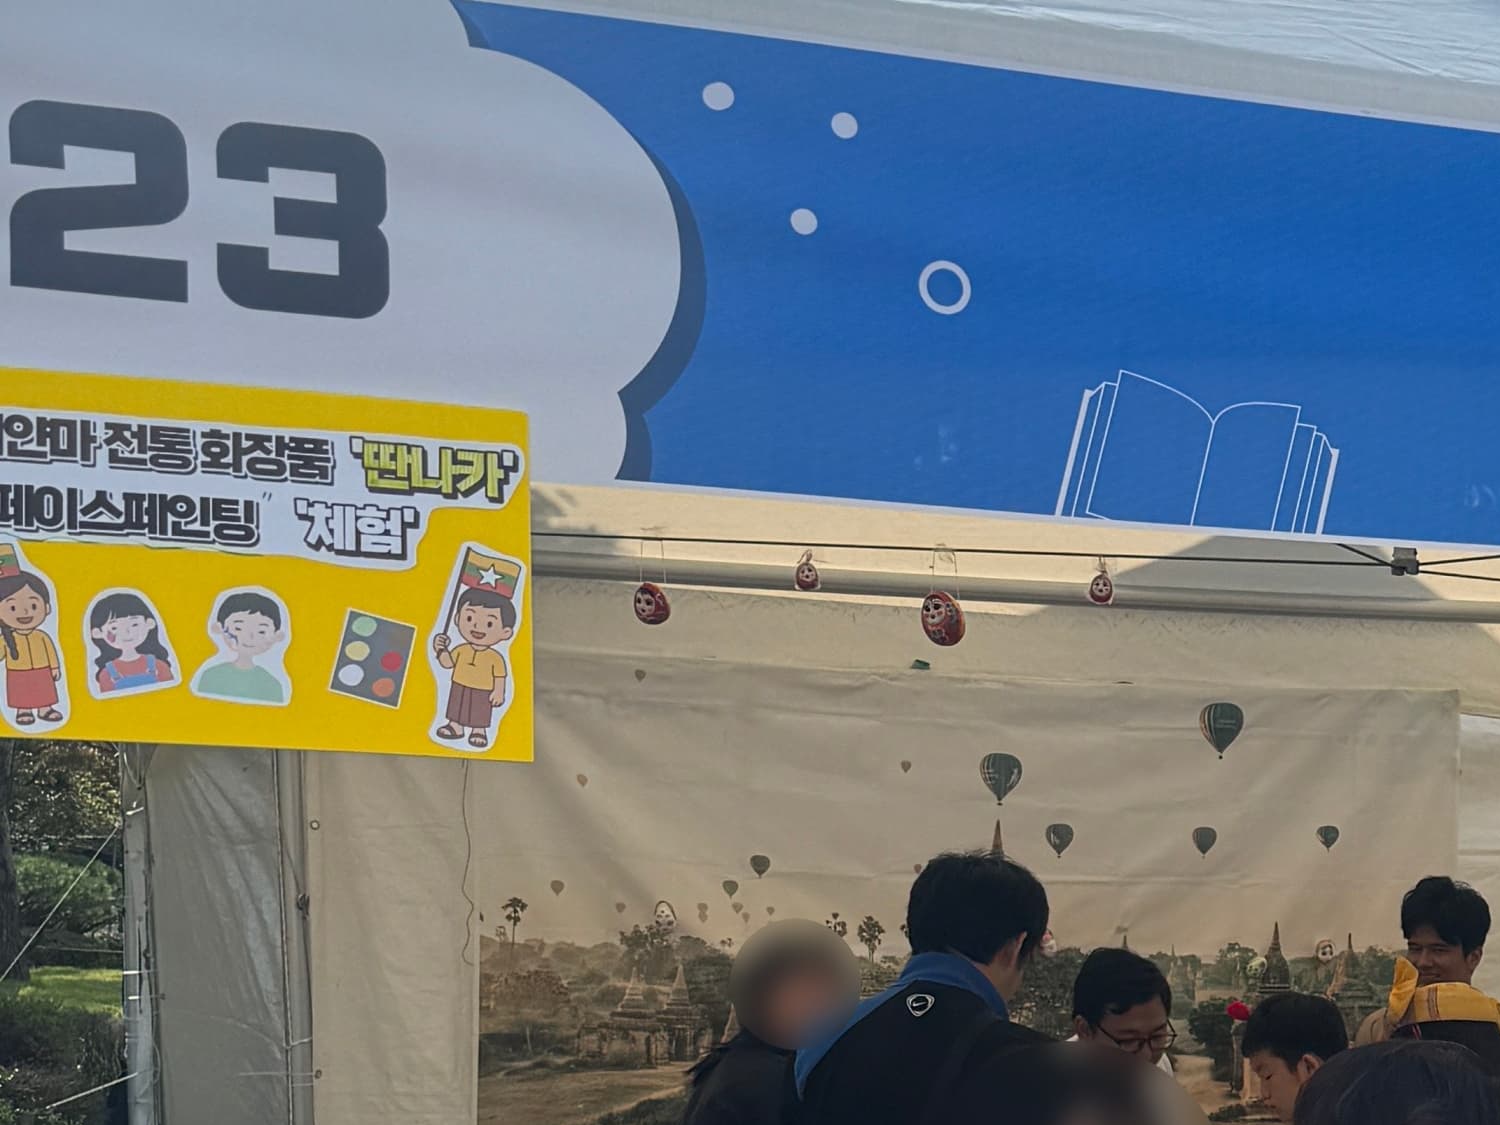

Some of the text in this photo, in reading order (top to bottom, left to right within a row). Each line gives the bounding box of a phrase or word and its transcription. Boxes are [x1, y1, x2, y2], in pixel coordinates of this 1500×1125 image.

[9, 99, 390, 320] 23
[103, 420, 199, 476] 전통
[199, 427, 337, 487] 화장품
